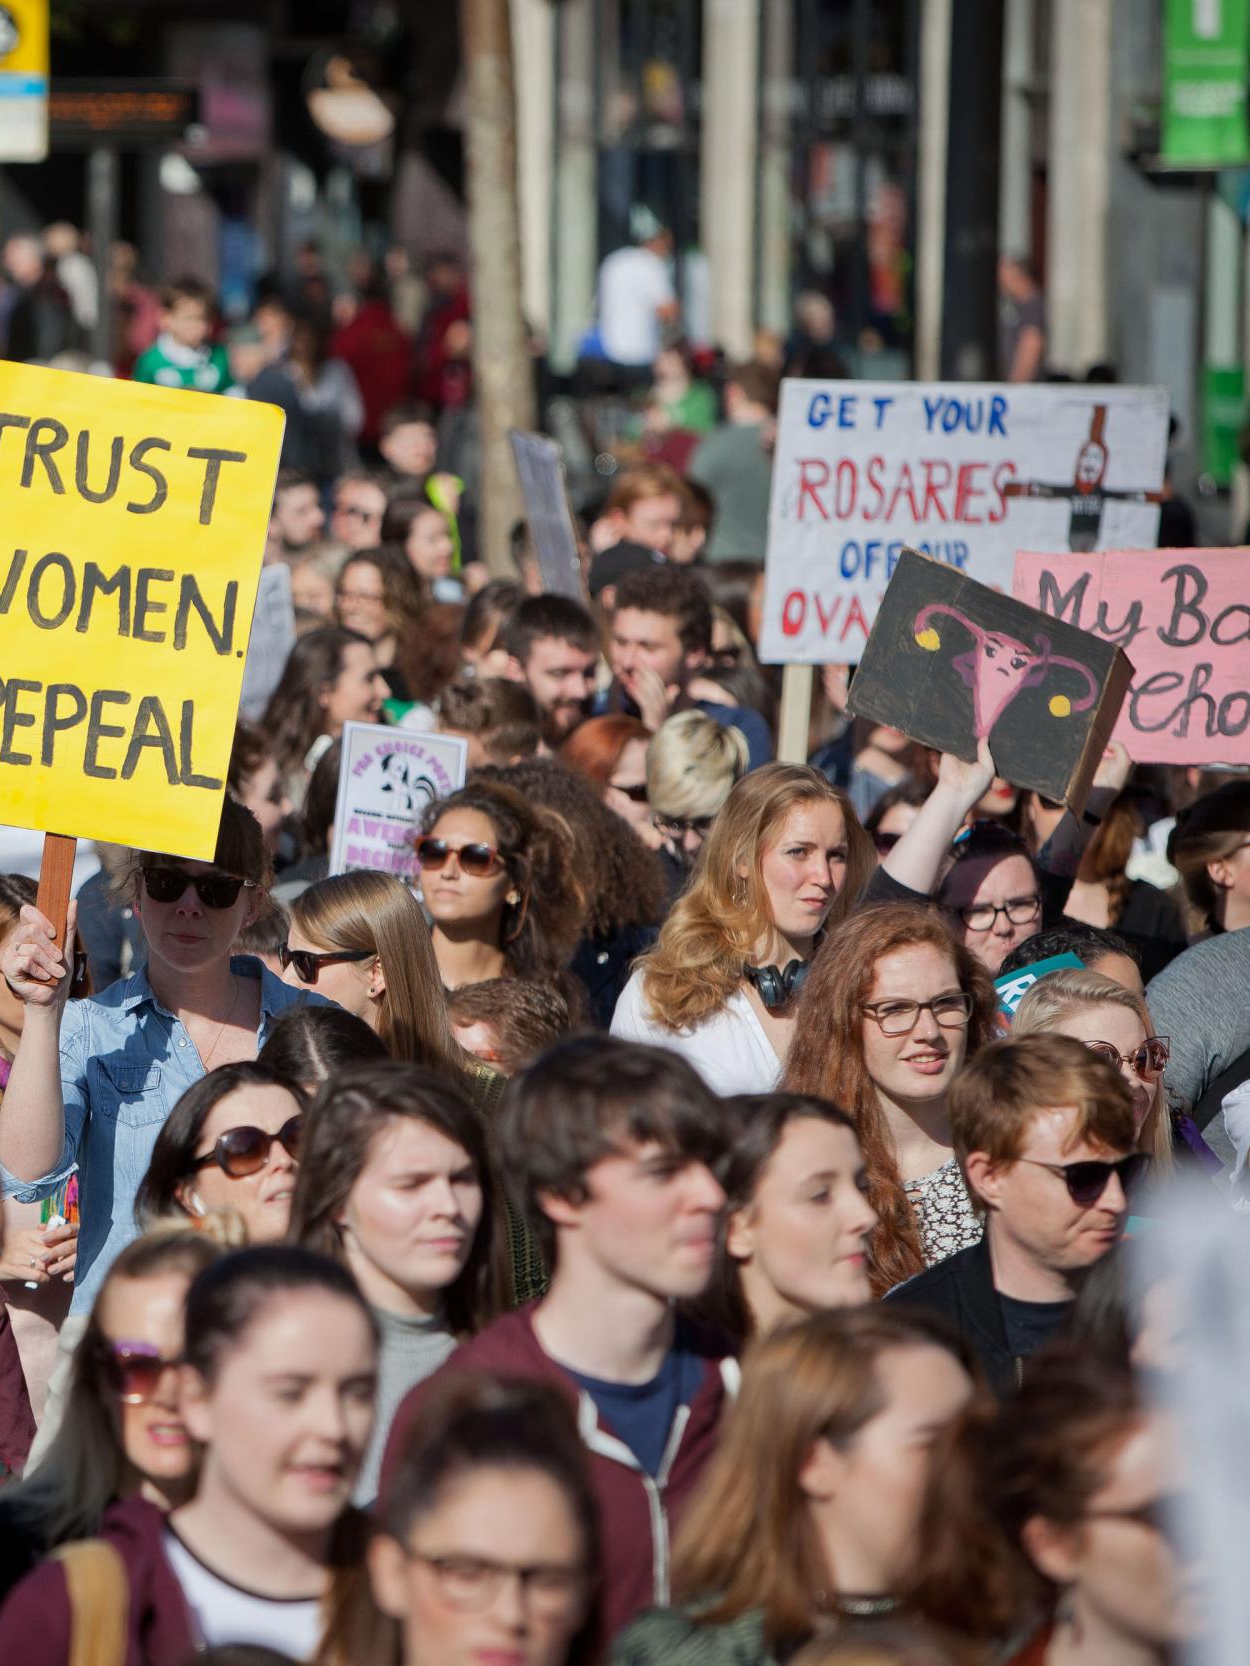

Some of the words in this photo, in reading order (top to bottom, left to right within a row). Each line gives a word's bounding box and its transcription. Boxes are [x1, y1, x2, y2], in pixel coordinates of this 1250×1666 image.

[807, 392, 894, 430] GET
[923, 394, 1010, 437] YOUR
[1038, 569, 1149, 648] My
